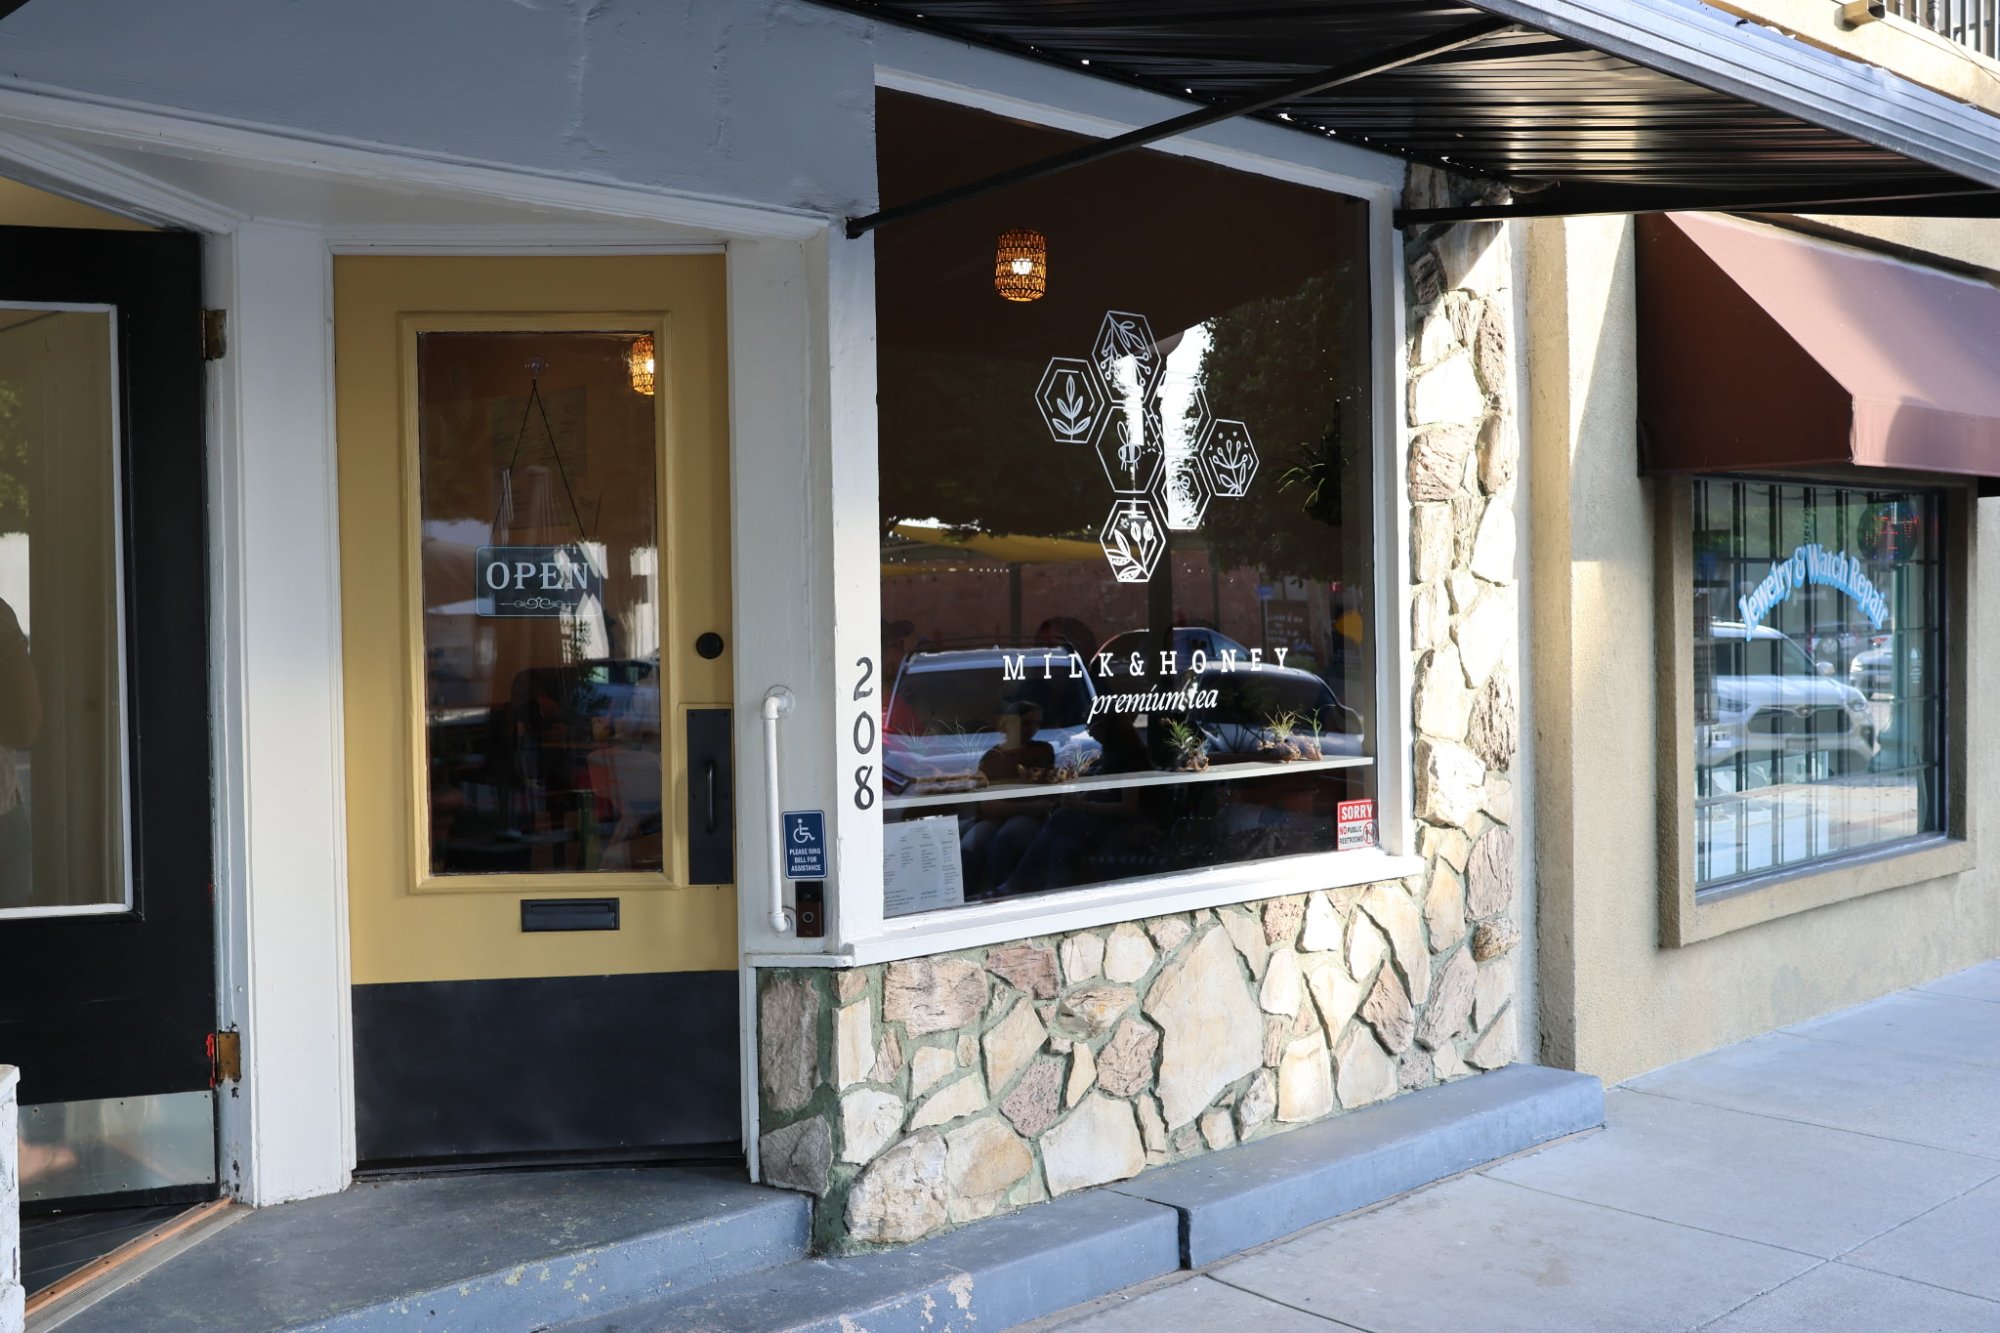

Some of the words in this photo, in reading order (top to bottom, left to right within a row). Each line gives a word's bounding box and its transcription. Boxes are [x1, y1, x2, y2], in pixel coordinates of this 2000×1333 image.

[485, 561, 589, 591] OPEN
[1739, 560, 1794, 641] Jewelry
[1793, 546, 1806, 588] &
[1805, 543, 1849, 591] Watch
[1848, 556, 1888, 630] Repair
[1086, 684, 1187, 725] premium
[1188, 686, 1219, 709] tea
[1341, 804, 1373, 821] SORRY
[789, 847, 808, 855] PLEASE
[790, 864, 822, 872] ASSISTANCE
